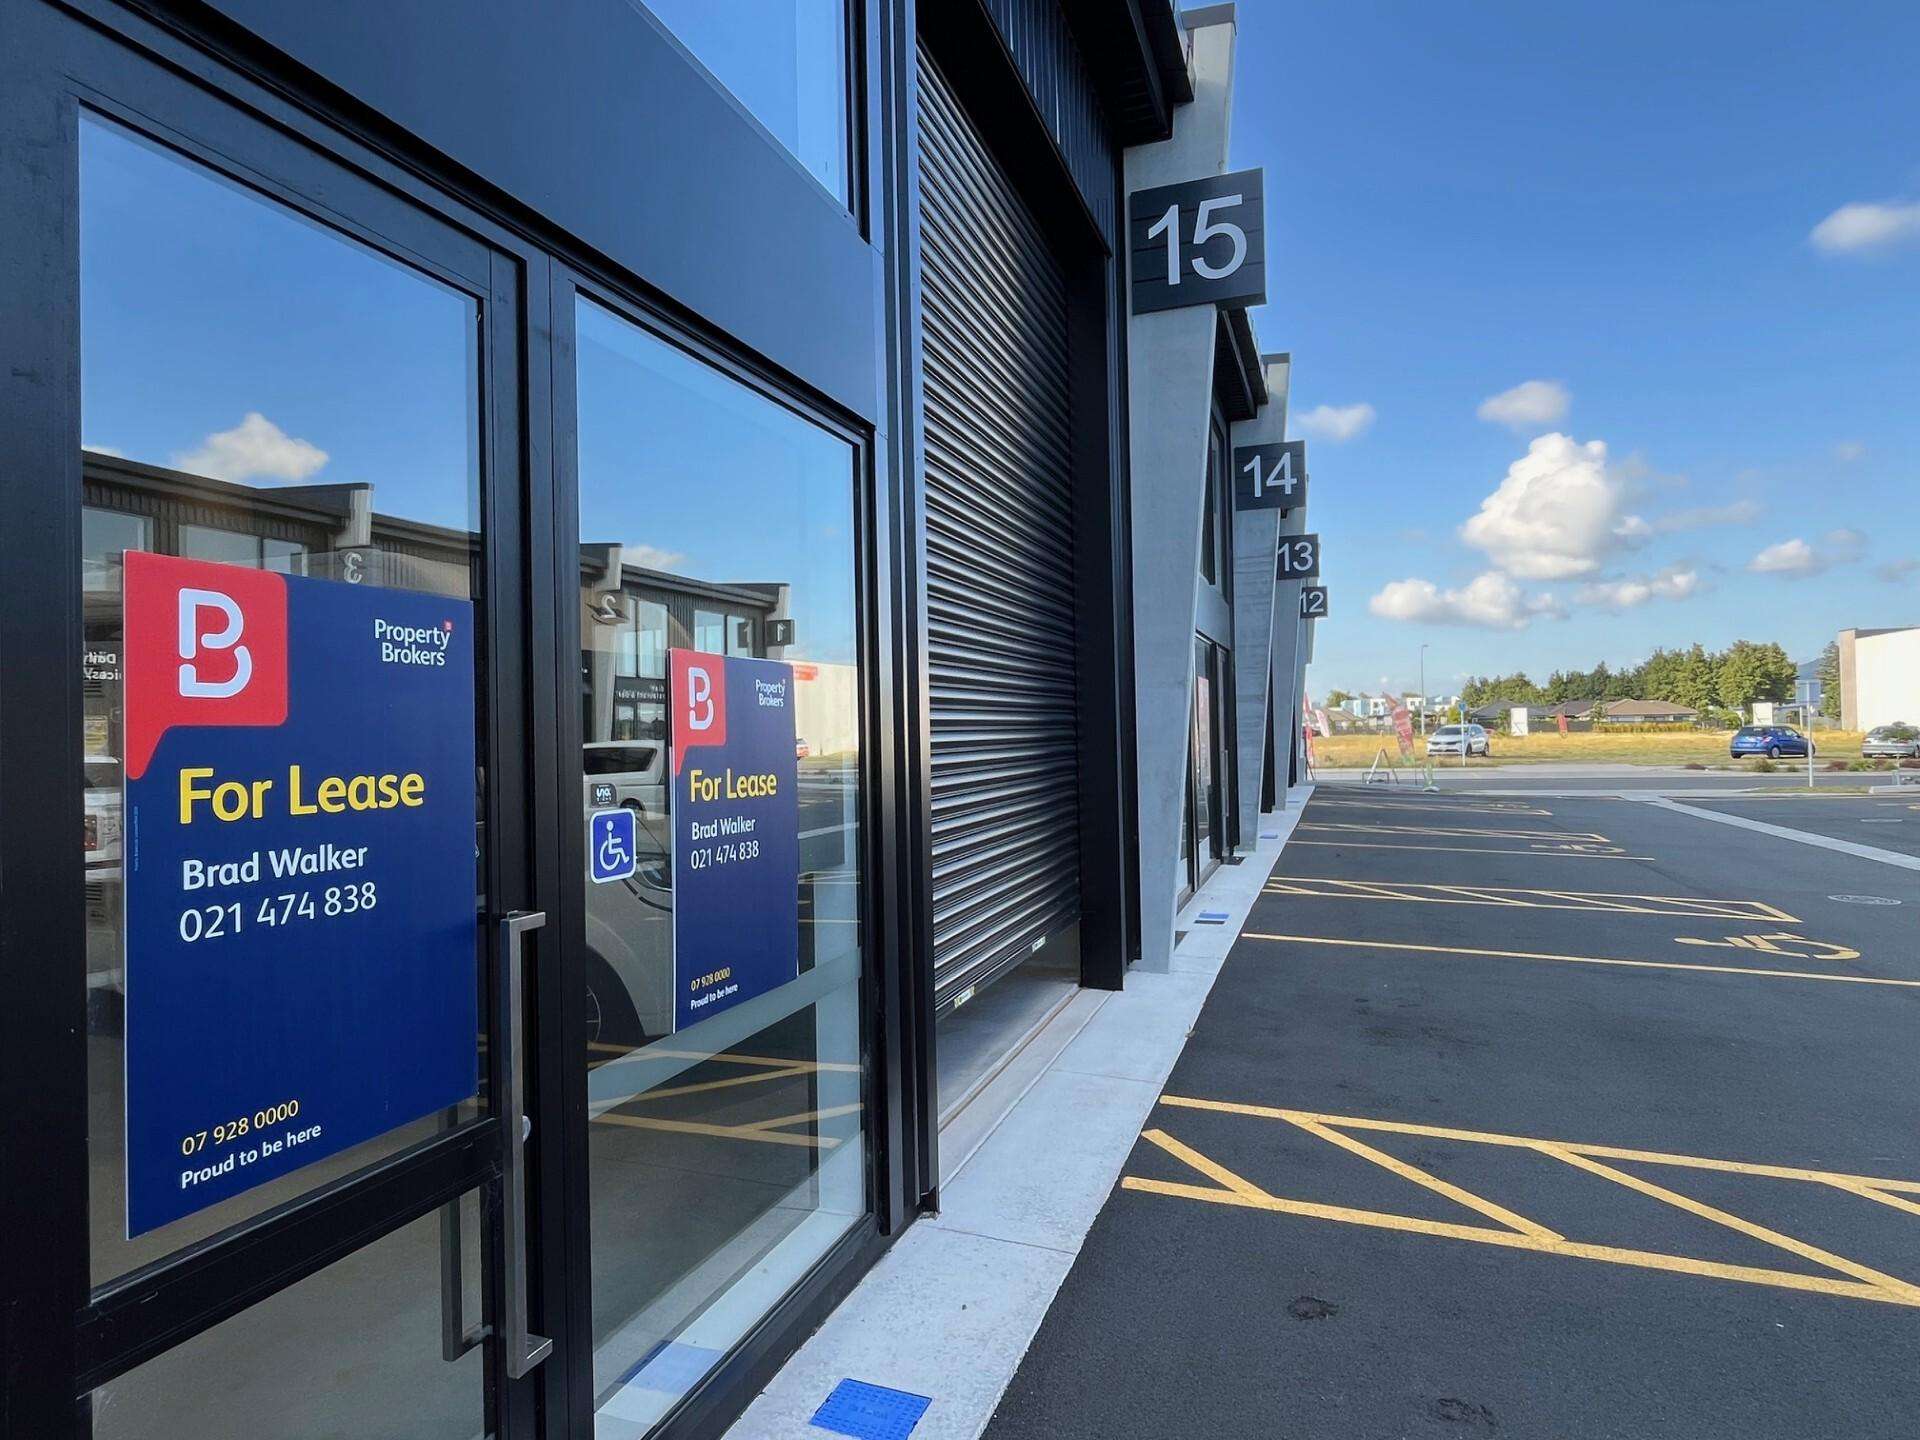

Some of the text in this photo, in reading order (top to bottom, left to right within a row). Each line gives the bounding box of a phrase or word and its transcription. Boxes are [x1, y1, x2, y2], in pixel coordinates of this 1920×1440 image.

[1147, 194, 1248, 286] 15
[1243, 451, 1298, 497] 14
[1278, 542, 1314, 572] 13
[1301, 591, 1325, 614] 12
[375, 618, 450, 650] Property
[382, 642, 446, 666] Brokers
[755, 679, 786, 696] Property
[758, 693, 785, 708] Brokers
[178, 765, 425, 825] For Lease
[690, 768, 777, 803] For Lease
[691, 816, 756, 841] Brad Walker
[182, 844, 369, 891] Brad Walker
[690, 840, 760, 870] 021 474 838
[179, 881, 378, 943] 021 474 838
[691, 968, 730, 991] 07 928 0000
[691, 984, 738, 1010] Proud to be here
[181, 1099, 300, 1156] 07 928 0000
[180, 1125, 321, 1189] Proud to be here
